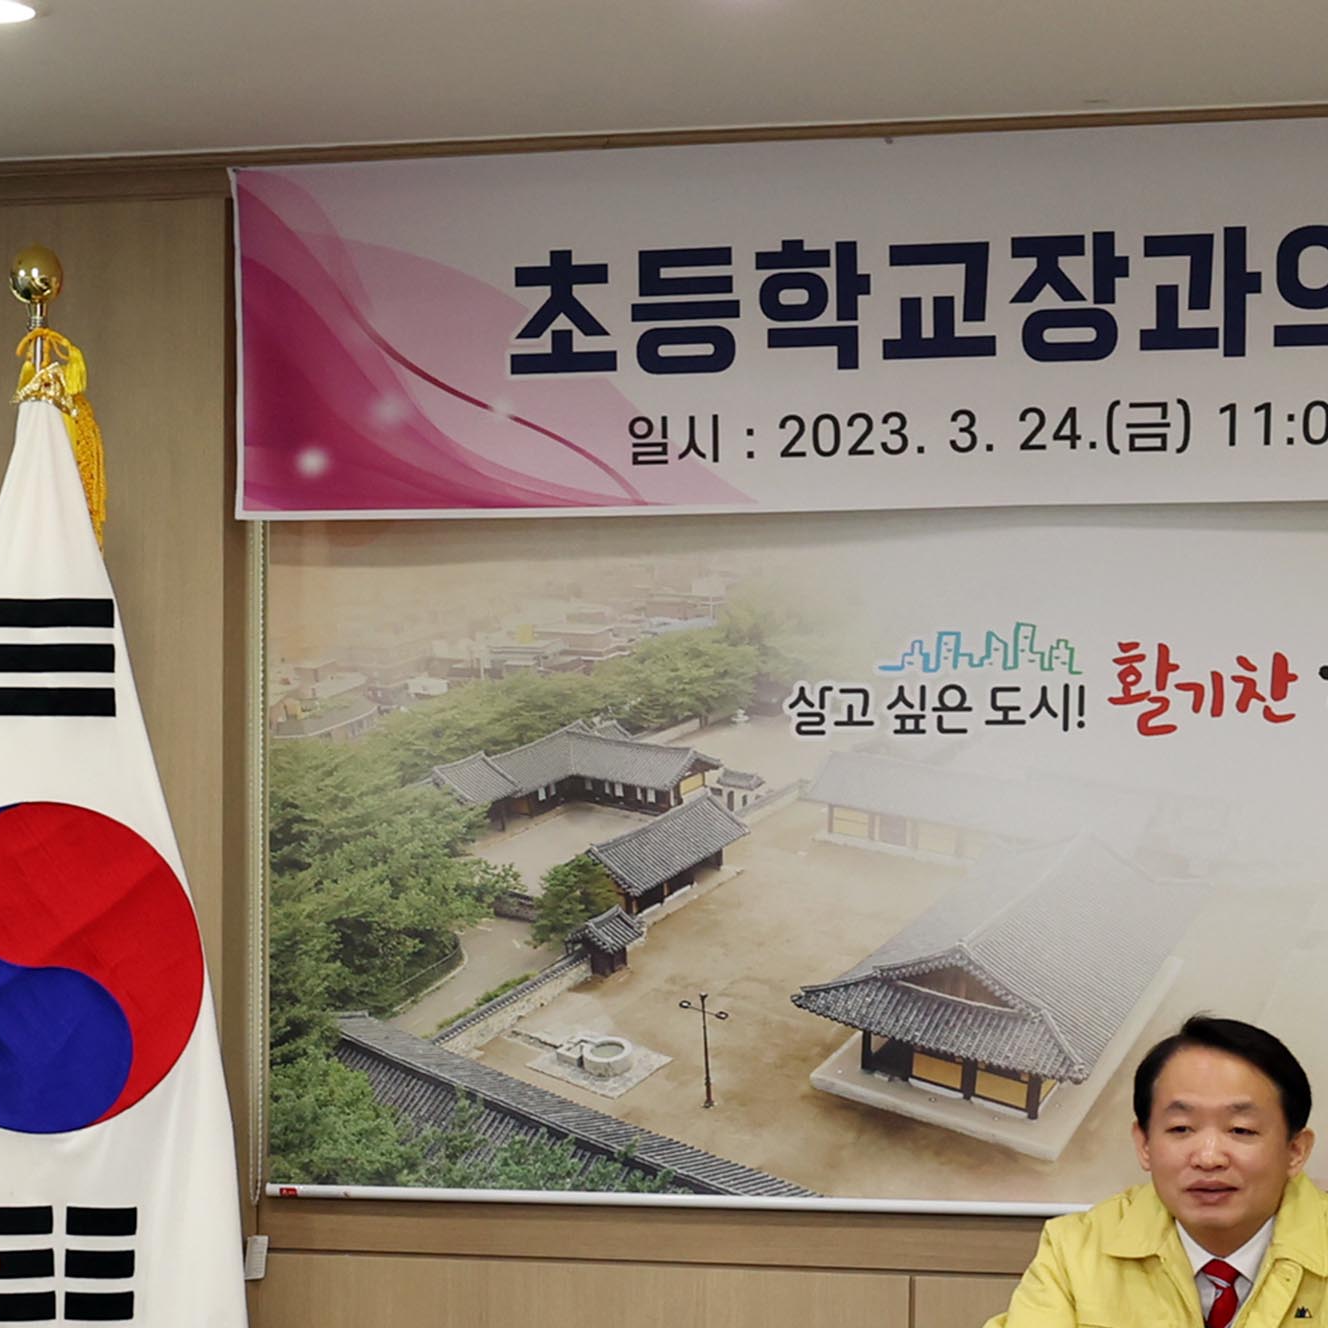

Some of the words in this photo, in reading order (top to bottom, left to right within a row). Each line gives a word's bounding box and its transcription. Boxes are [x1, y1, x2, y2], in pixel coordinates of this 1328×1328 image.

[628, 413, 719, 466] 일시
[778, 411, 925, 459] 2023.
[949, 409, 994, 454] 3.
[1018, 397, 1191, 455] 24.(금)
[788, 685, 875, 736] 살고
[886, 684, 973, 735] 싶은
[984, 683, 1086, 732] 도시!
[1107, 641, 1298, 737] 활기찬
